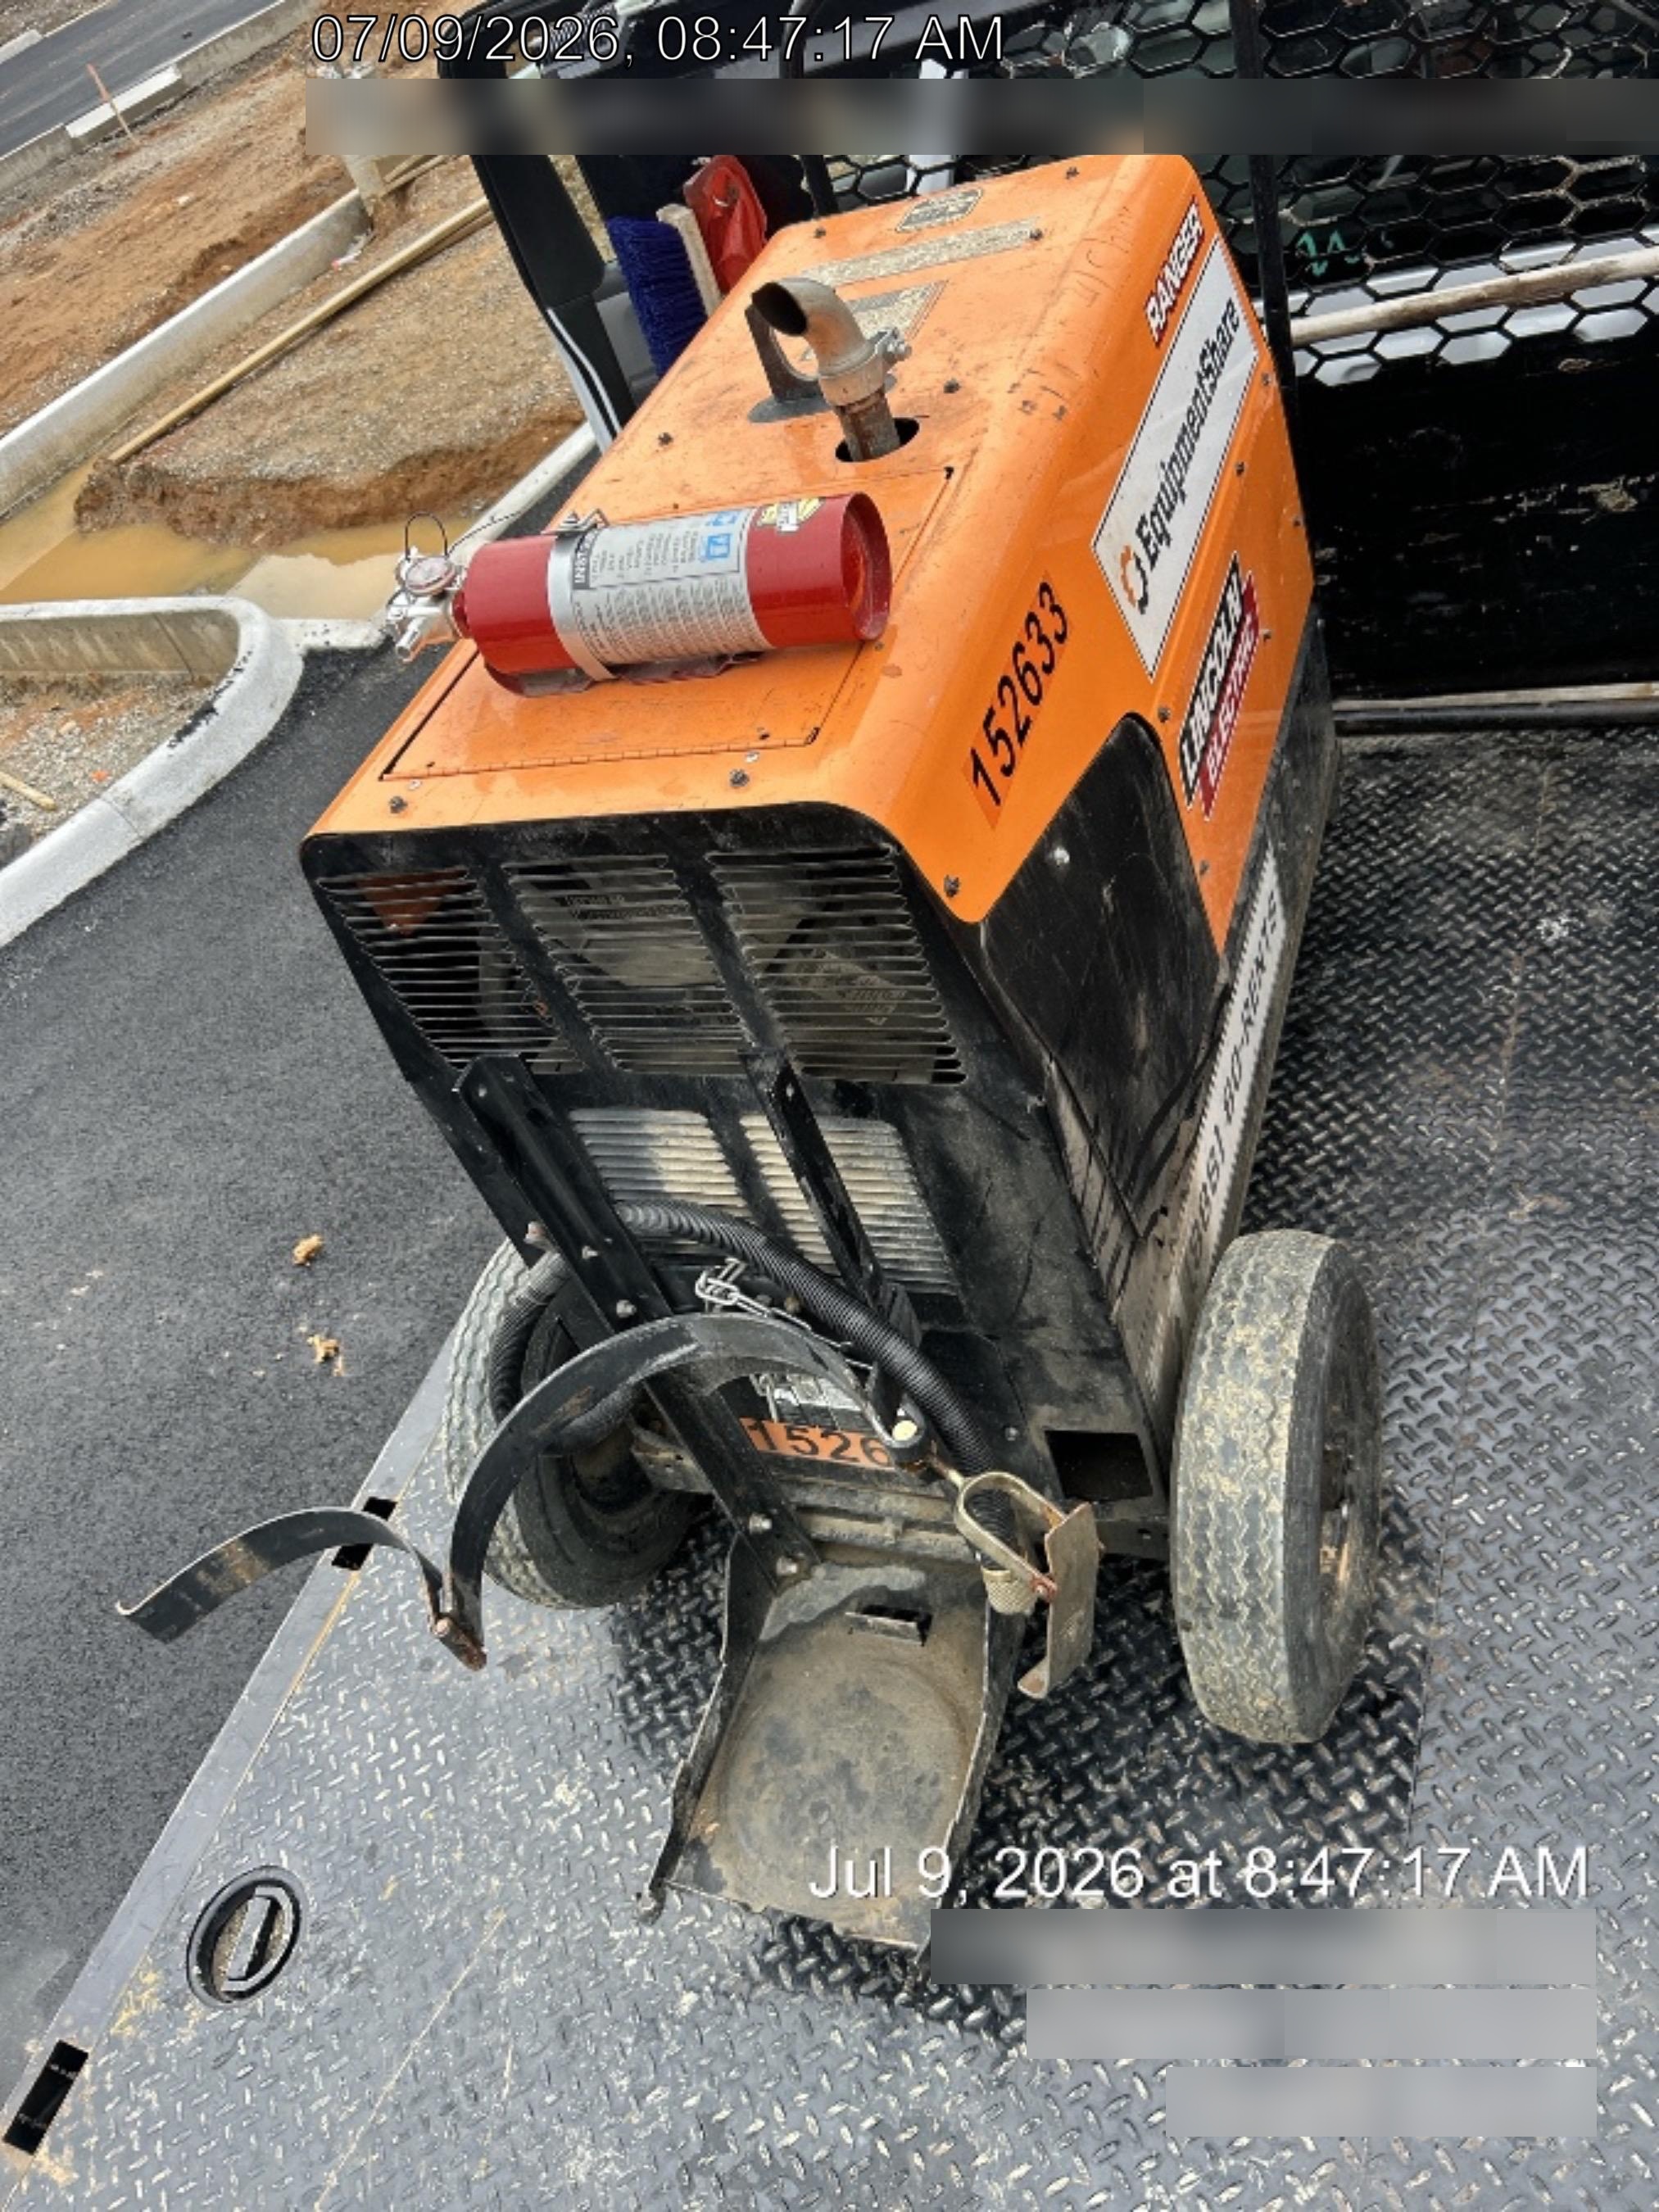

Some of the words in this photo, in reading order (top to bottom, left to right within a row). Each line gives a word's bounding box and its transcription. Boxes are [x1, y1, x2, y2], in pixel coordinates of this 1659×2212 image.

[1145, 201, 1203, 342] RANGER
[1135, 297, 1240, 571] EquipmentShare
[968, 582, 1068, 806] 152633
[1182, 572, 1242, 789] LINCOLN
[1207, 613, 1254, 788] ELECTRIC
